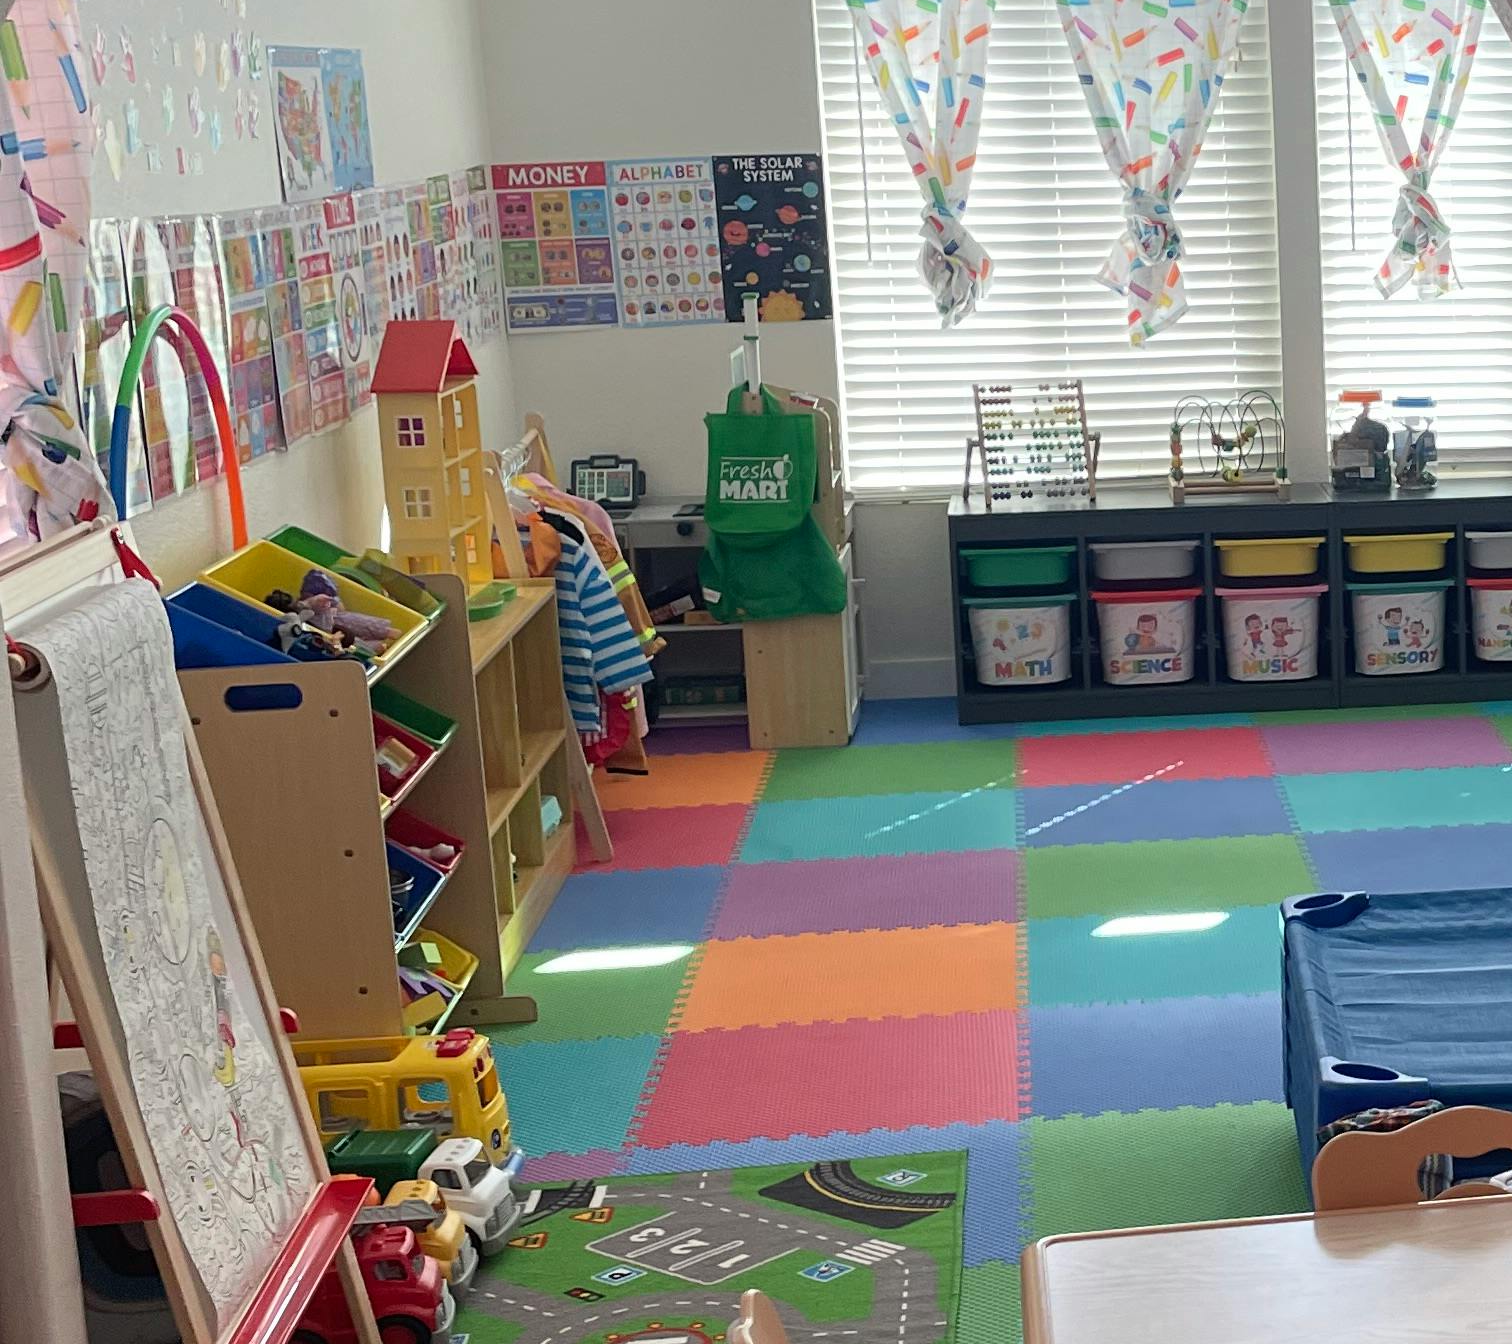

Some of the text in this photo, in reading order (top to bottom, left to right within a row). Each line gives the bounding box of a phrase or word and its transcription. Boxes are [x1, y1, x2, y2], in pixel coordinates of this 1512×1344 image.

[732, 157, 803, 170] THE SOLAR
[508, 166, 588, 186] MONEY
[619, 164, 703, 182] ALPHABET
[743, 170, 793, 182] SYSTEM
[720, 458, 774, 479] Fresh
[719, 480, 790, 500] MART
[1110, 657, 1182, 675] SCIENCE
[1243, 657, 1298, 674] MUSIC
[1367, 650, 1438, 666] SENSORY
[995, 659, 1053, 678] MATH
